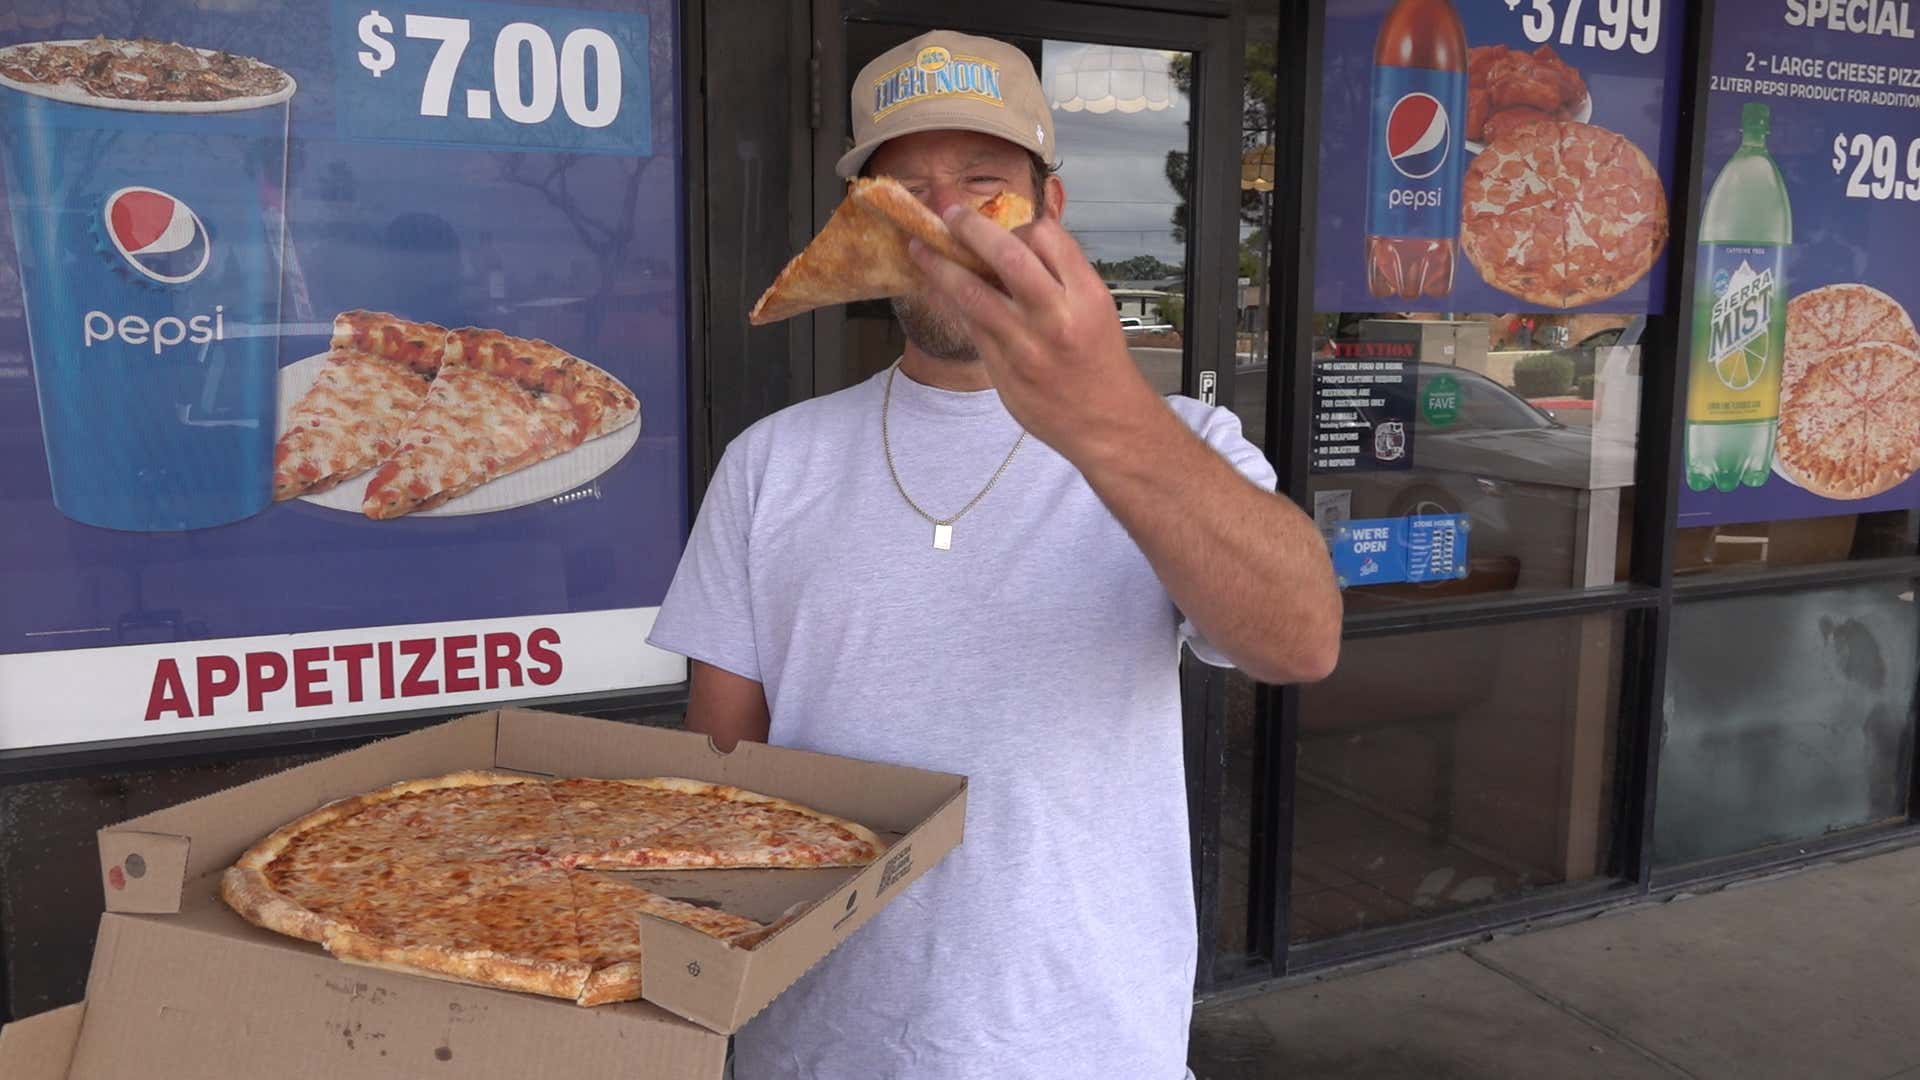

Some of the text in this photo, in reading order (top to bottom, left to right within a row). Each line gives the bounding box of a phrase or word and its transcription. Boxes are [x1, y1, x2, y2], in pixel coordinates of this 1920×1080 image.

[1784, 0, 1915, 39] SPECIAL
[357, 10, 622, 128] $7.00
[874, 61, 1003, 113] HIGH NOON
[1745, 52, 1756, 72] 2
[1771, 55, 1824, 79] LARGE
[1826, 60, 1887, 85] CHEESE
[1710, 76, 1719, 90] 2
[1720, 77, 1752, 93] LITER
[1754, 80, 1788, 97] PEPSI
[1790, 83, 1846, 102] PRODUCT
[1847, 88, 1870, 103] FOR
[1388, 187, 1442, 211] pepsi
[1712, 268, 1772, 320] SIERRA
[84, 305, 225, 354] pepsi
[1711, 285, 1774, 358] MIST
[1429, 397, 1456, 410] FAVE
[1352, 527, 1390, 541] WE'RE
[1353, 541, 1387, 554] OPEN
[144, 627, 563, 722] APPETIZERS
